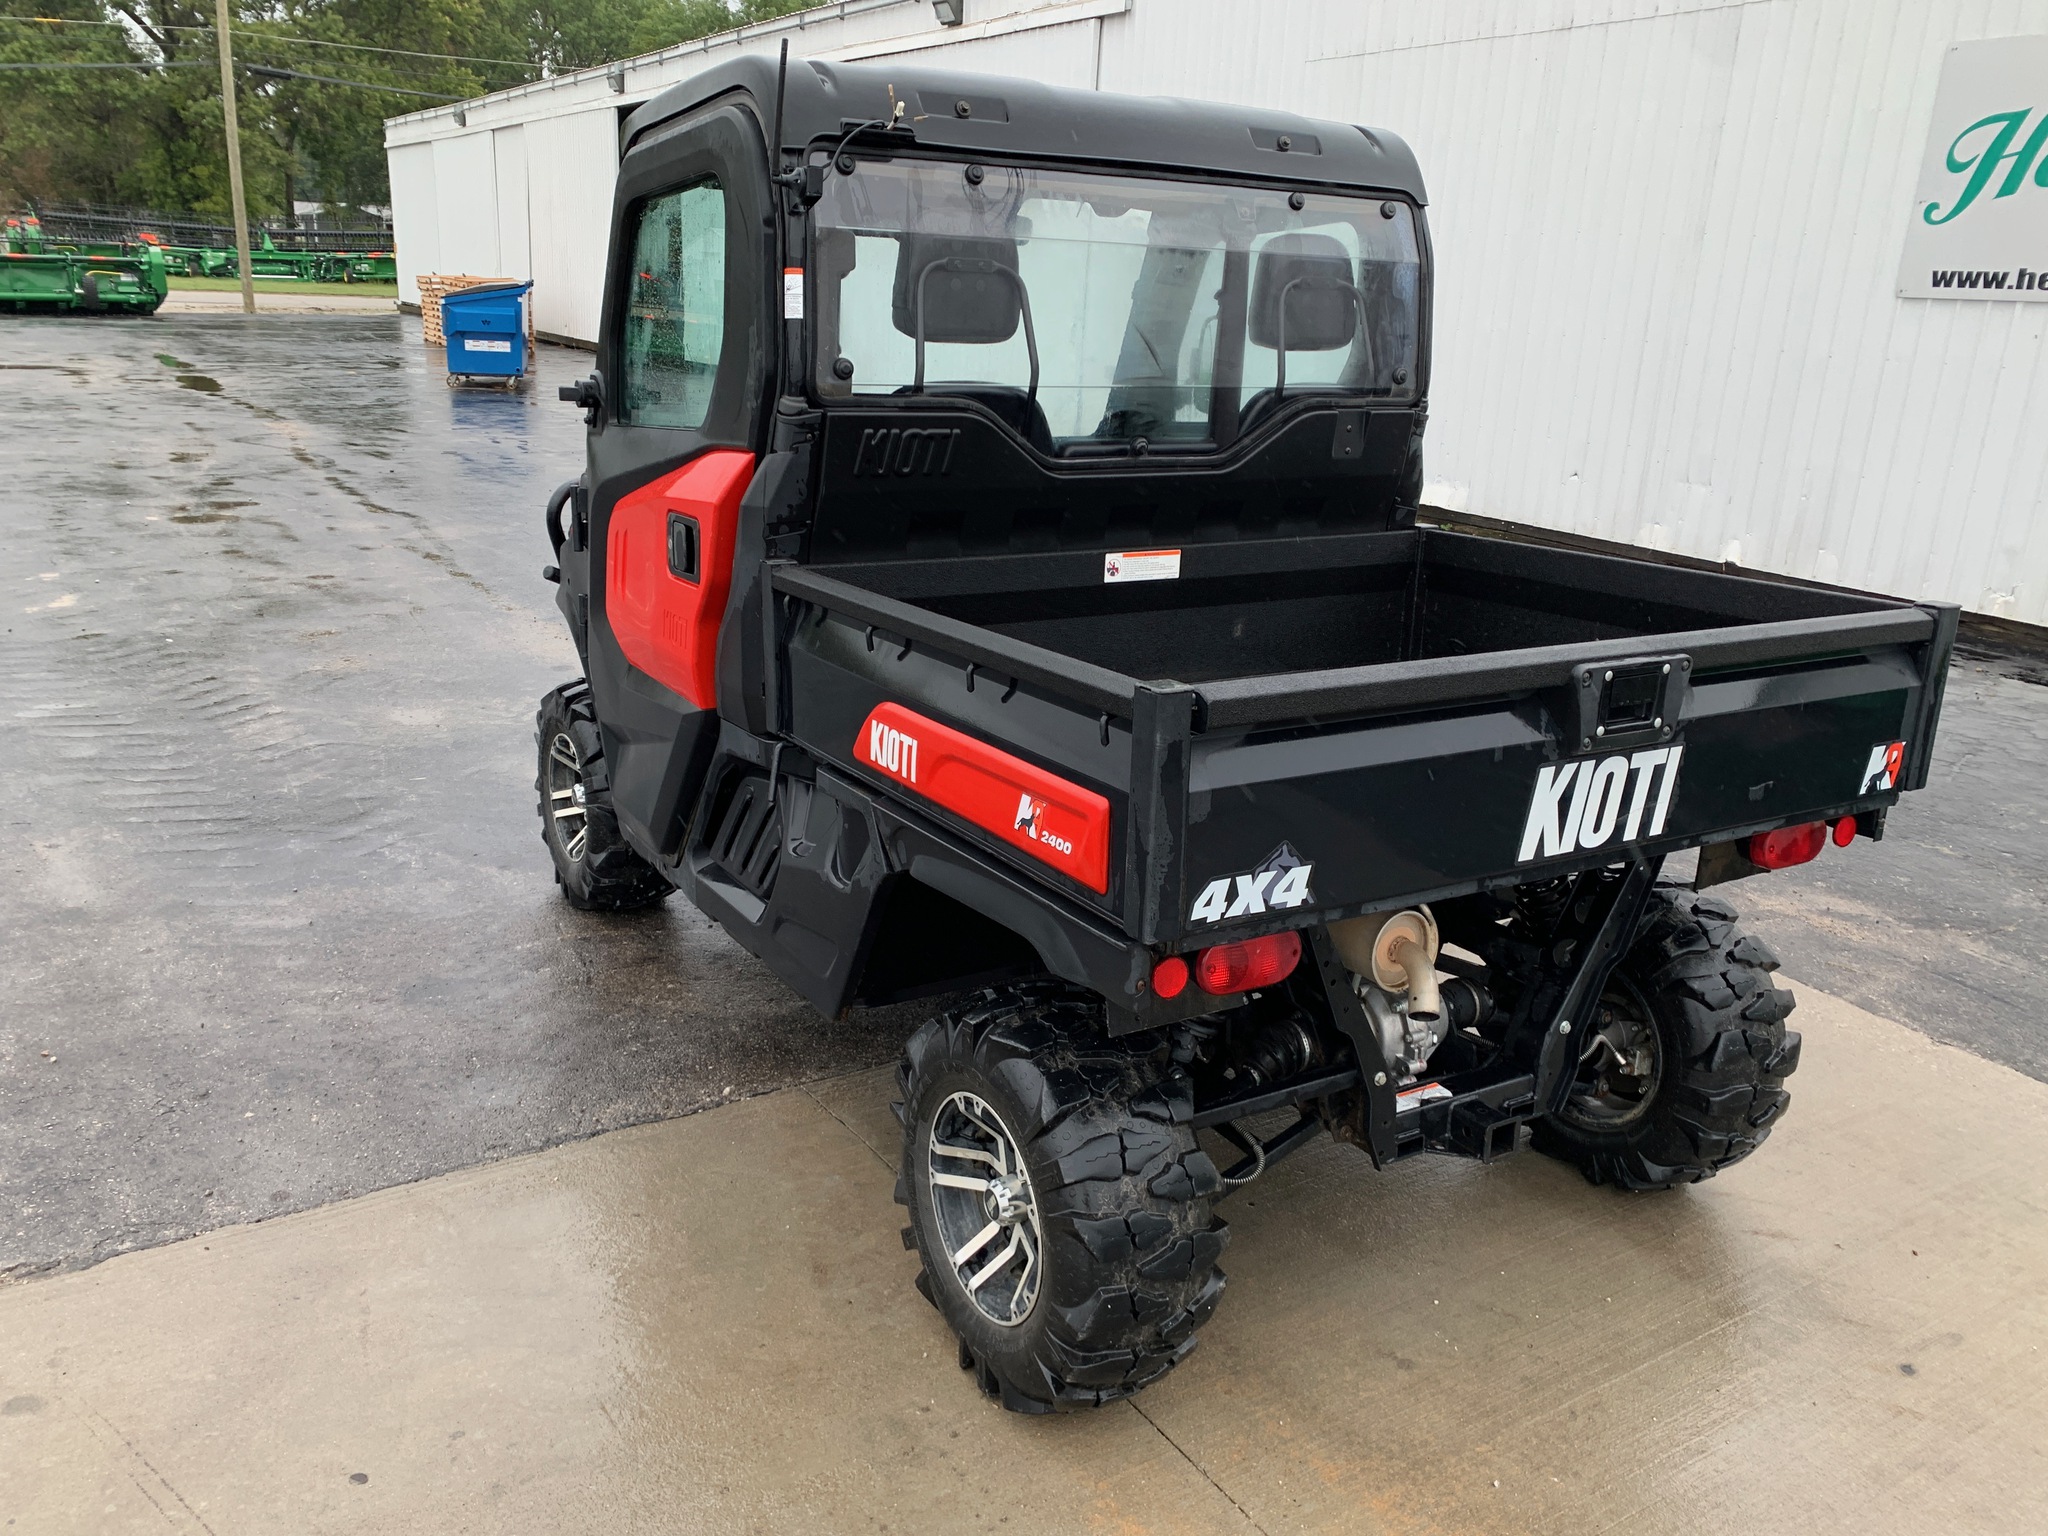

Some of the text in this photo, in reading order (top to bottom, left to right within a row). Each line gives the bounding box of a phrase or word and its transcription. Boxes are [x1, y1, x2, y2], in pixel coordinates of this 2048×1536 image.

[1923, 106, 2048, 225] H
[853, 428, 961, 477] KIOTI
[870, 719, 918, 784] KIOTI
[1518, 745, 1684, 863] KIOTI
[1041, 830, 1072, 855] 2400
